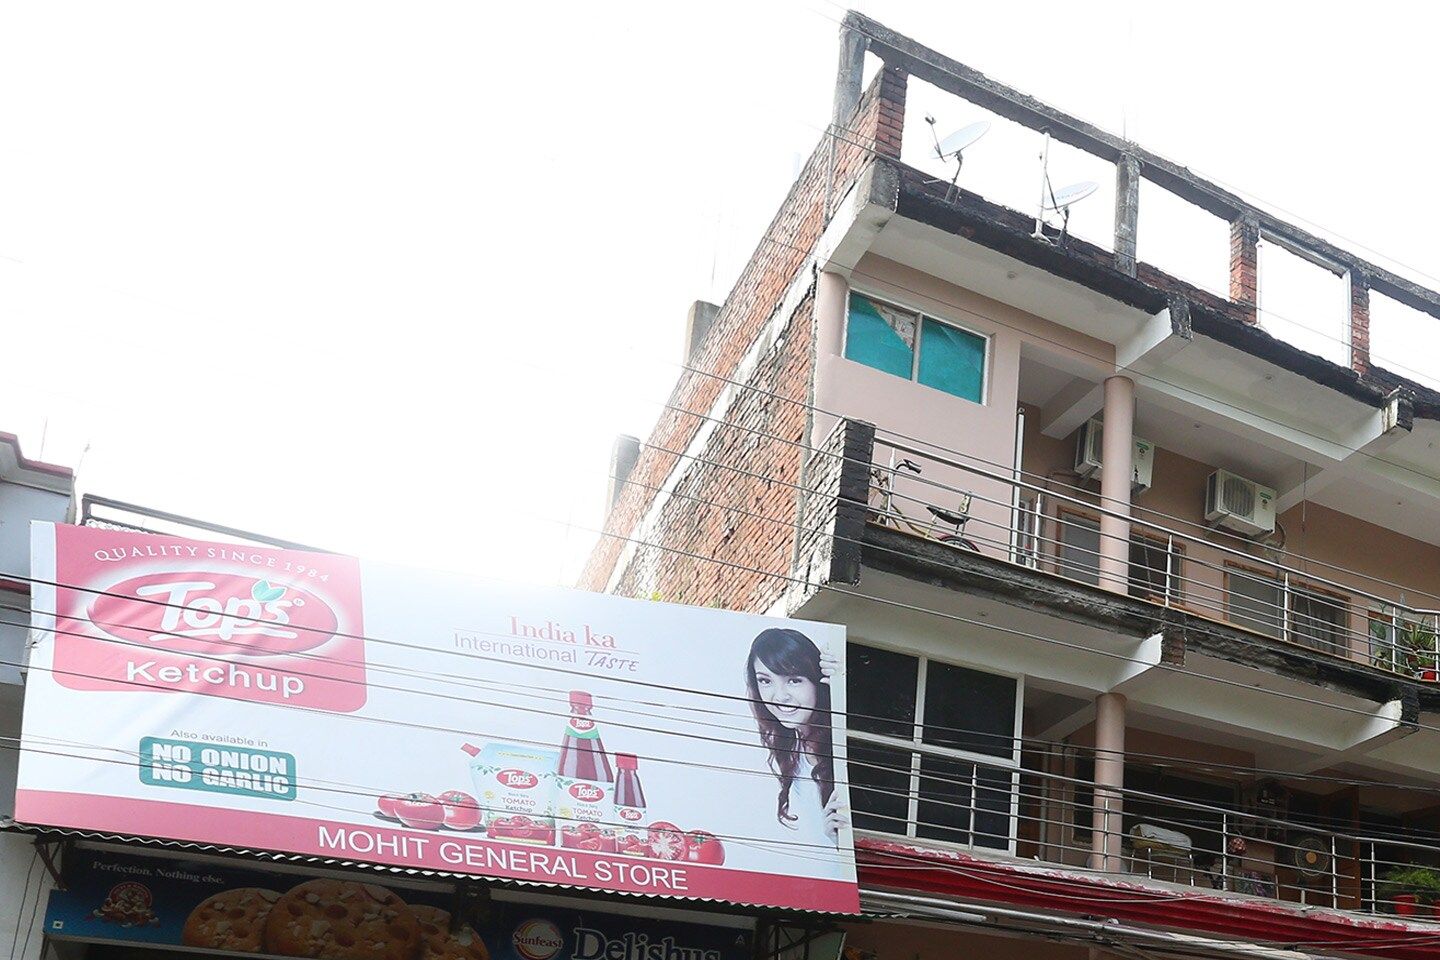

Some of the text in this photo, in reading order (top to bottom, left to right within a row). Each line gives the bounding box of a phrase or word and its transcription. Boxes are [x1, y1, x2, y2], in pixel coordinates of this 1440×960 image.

[94, 545, 330, 583] QUALITY SINCE 1984
[510, 616, 617, 649] India ka
[454, 632, 640, 672] International TASTE
[127, 661, 305, 699] Ketchup
[171, 729, 268, 748] Also available in
[152, 742, 287, 775] NO ONION
[152, 762, 289, 795] NO GARLIC
[501, 796, 536, 807] TOMATO
[572, 807, 602, 818] TOMATO
[92, 860, 152, 877] Perfection.
[155, 868, 200, 883] Nothing
[318, 825, 690, 891] MOHIT GENERAL STORE
[513, 931, 564, 951] Sunfeast
